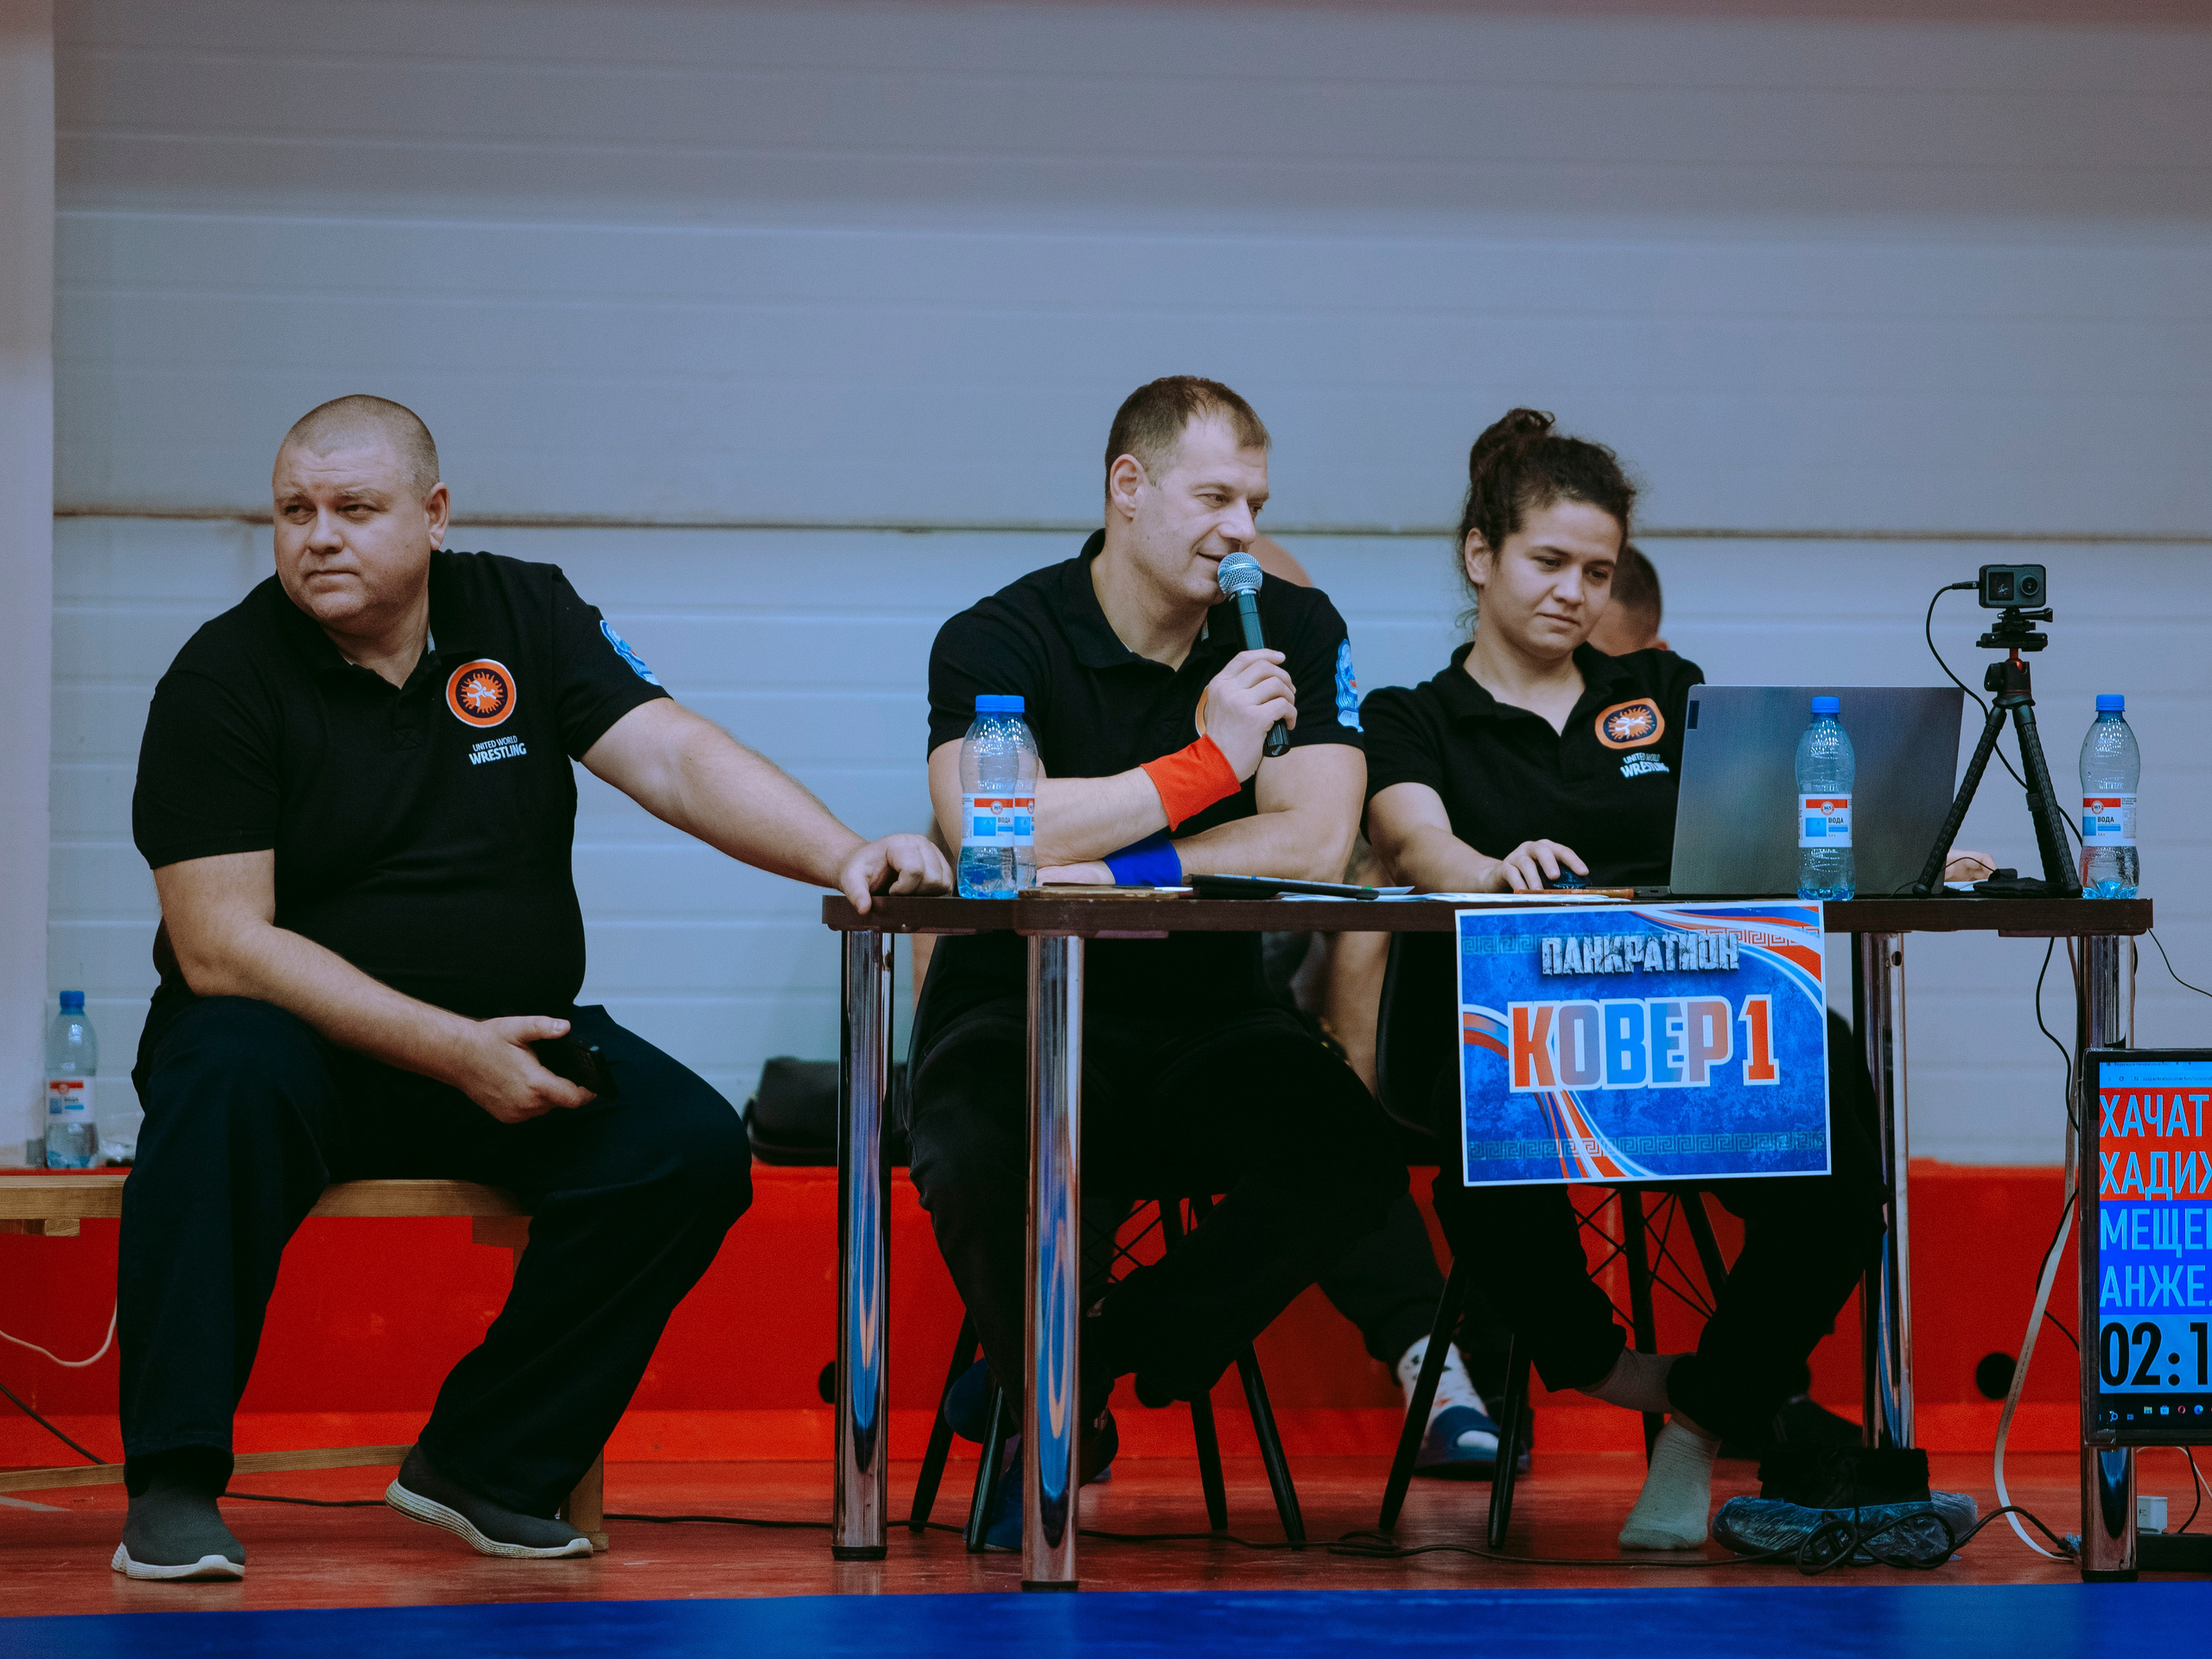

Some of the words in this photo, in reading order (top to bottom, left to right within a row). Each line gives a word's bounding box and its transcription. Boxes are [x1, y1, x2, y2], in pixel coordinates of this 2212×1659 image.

[469, 743, 527, 765] WRESTLING
[473, 740, 496, 752] UNITED
[496, 735, 518, 747] WORLD
[1623, 752, 1645, 764] UNITED
[1541, 933, 1740, 976] ПАНКРАТИОН
[1508, 996, 1732, 1092] КОВЕР
[2100, 1094, 2209, 1137] ХАЧАТ
[2101, 1208, 2212, 1258] МЕЩЕ
[2100, 1265, 2212, 1307] АНЖЕ
[2101, 1321, 2208, 1386] 02:1
